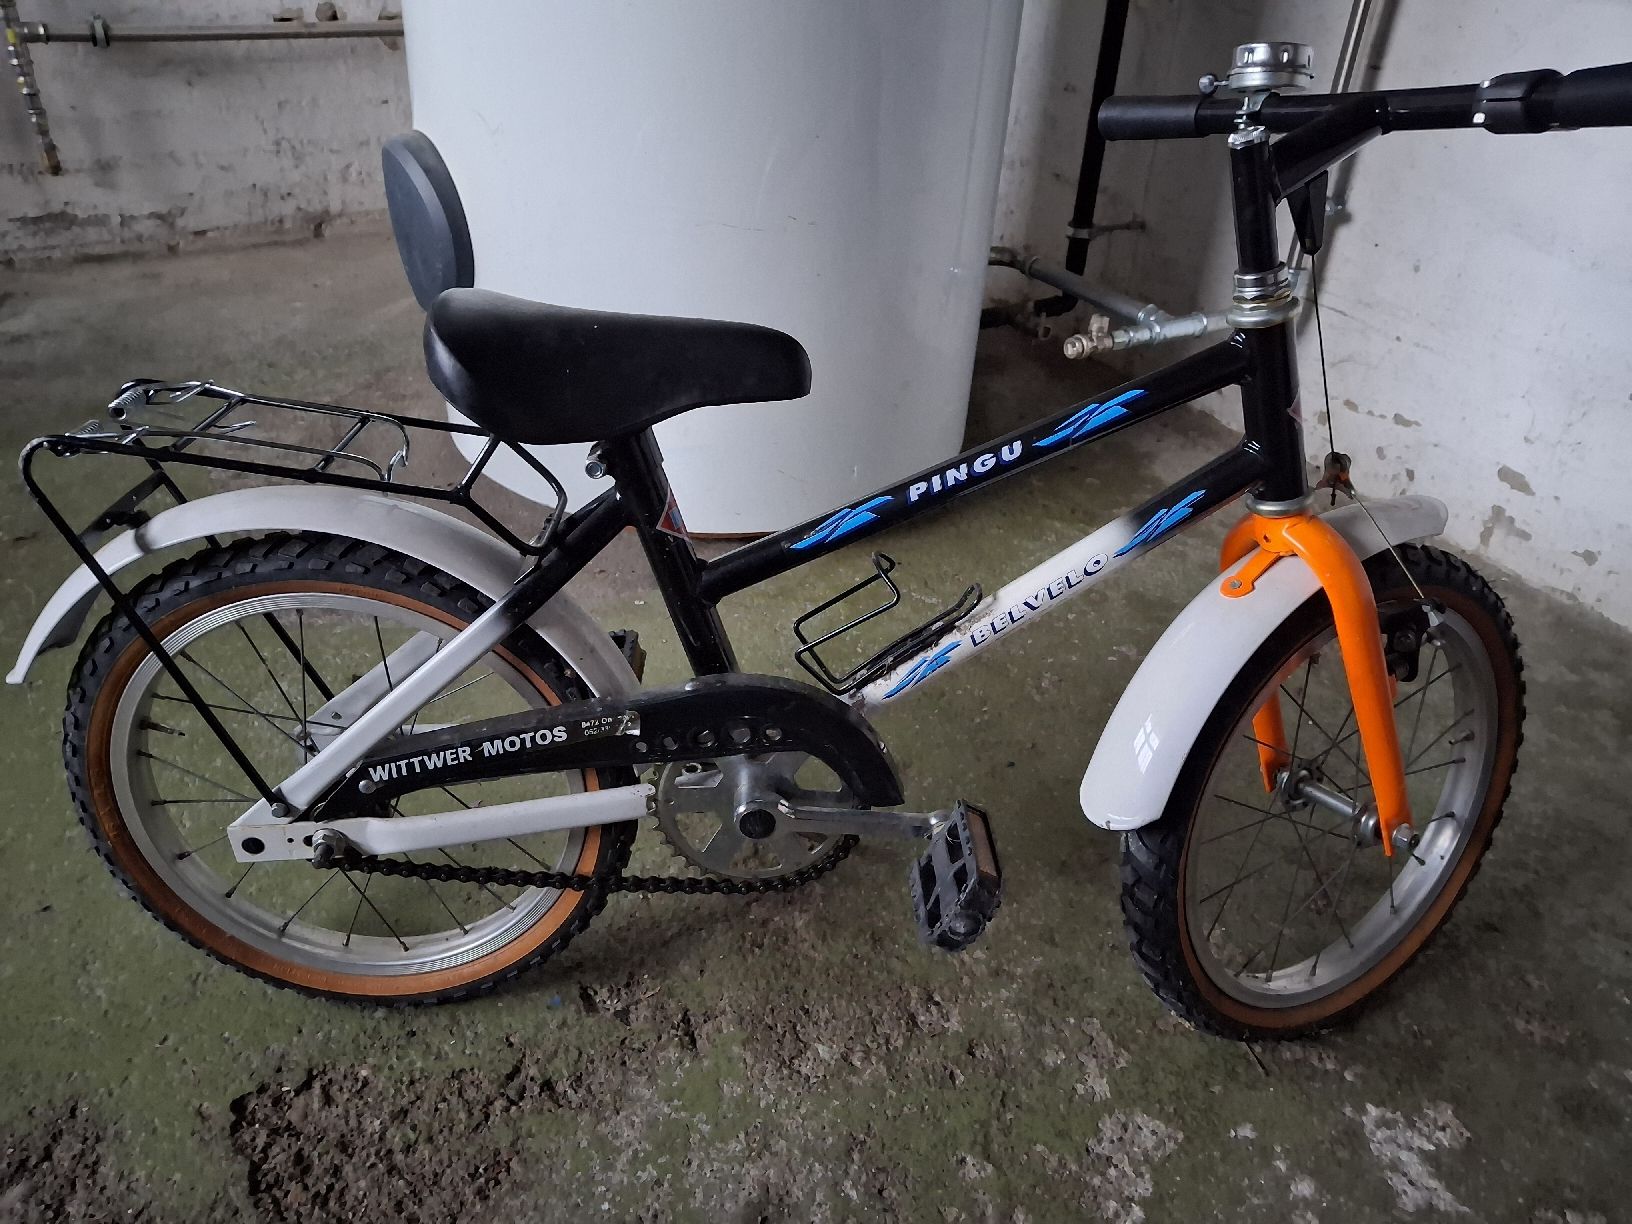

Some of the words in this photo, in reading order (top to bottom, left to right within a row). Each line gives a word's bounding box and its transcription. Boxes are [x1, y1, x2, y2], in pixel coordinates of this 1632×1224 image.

[907, 440, 1023, 503] PINGU
[970, 553, 1108, 647] BELVELO
[368, 747, 472, 782] WITTWER
[482, 726, 568, 757] MOTOS
